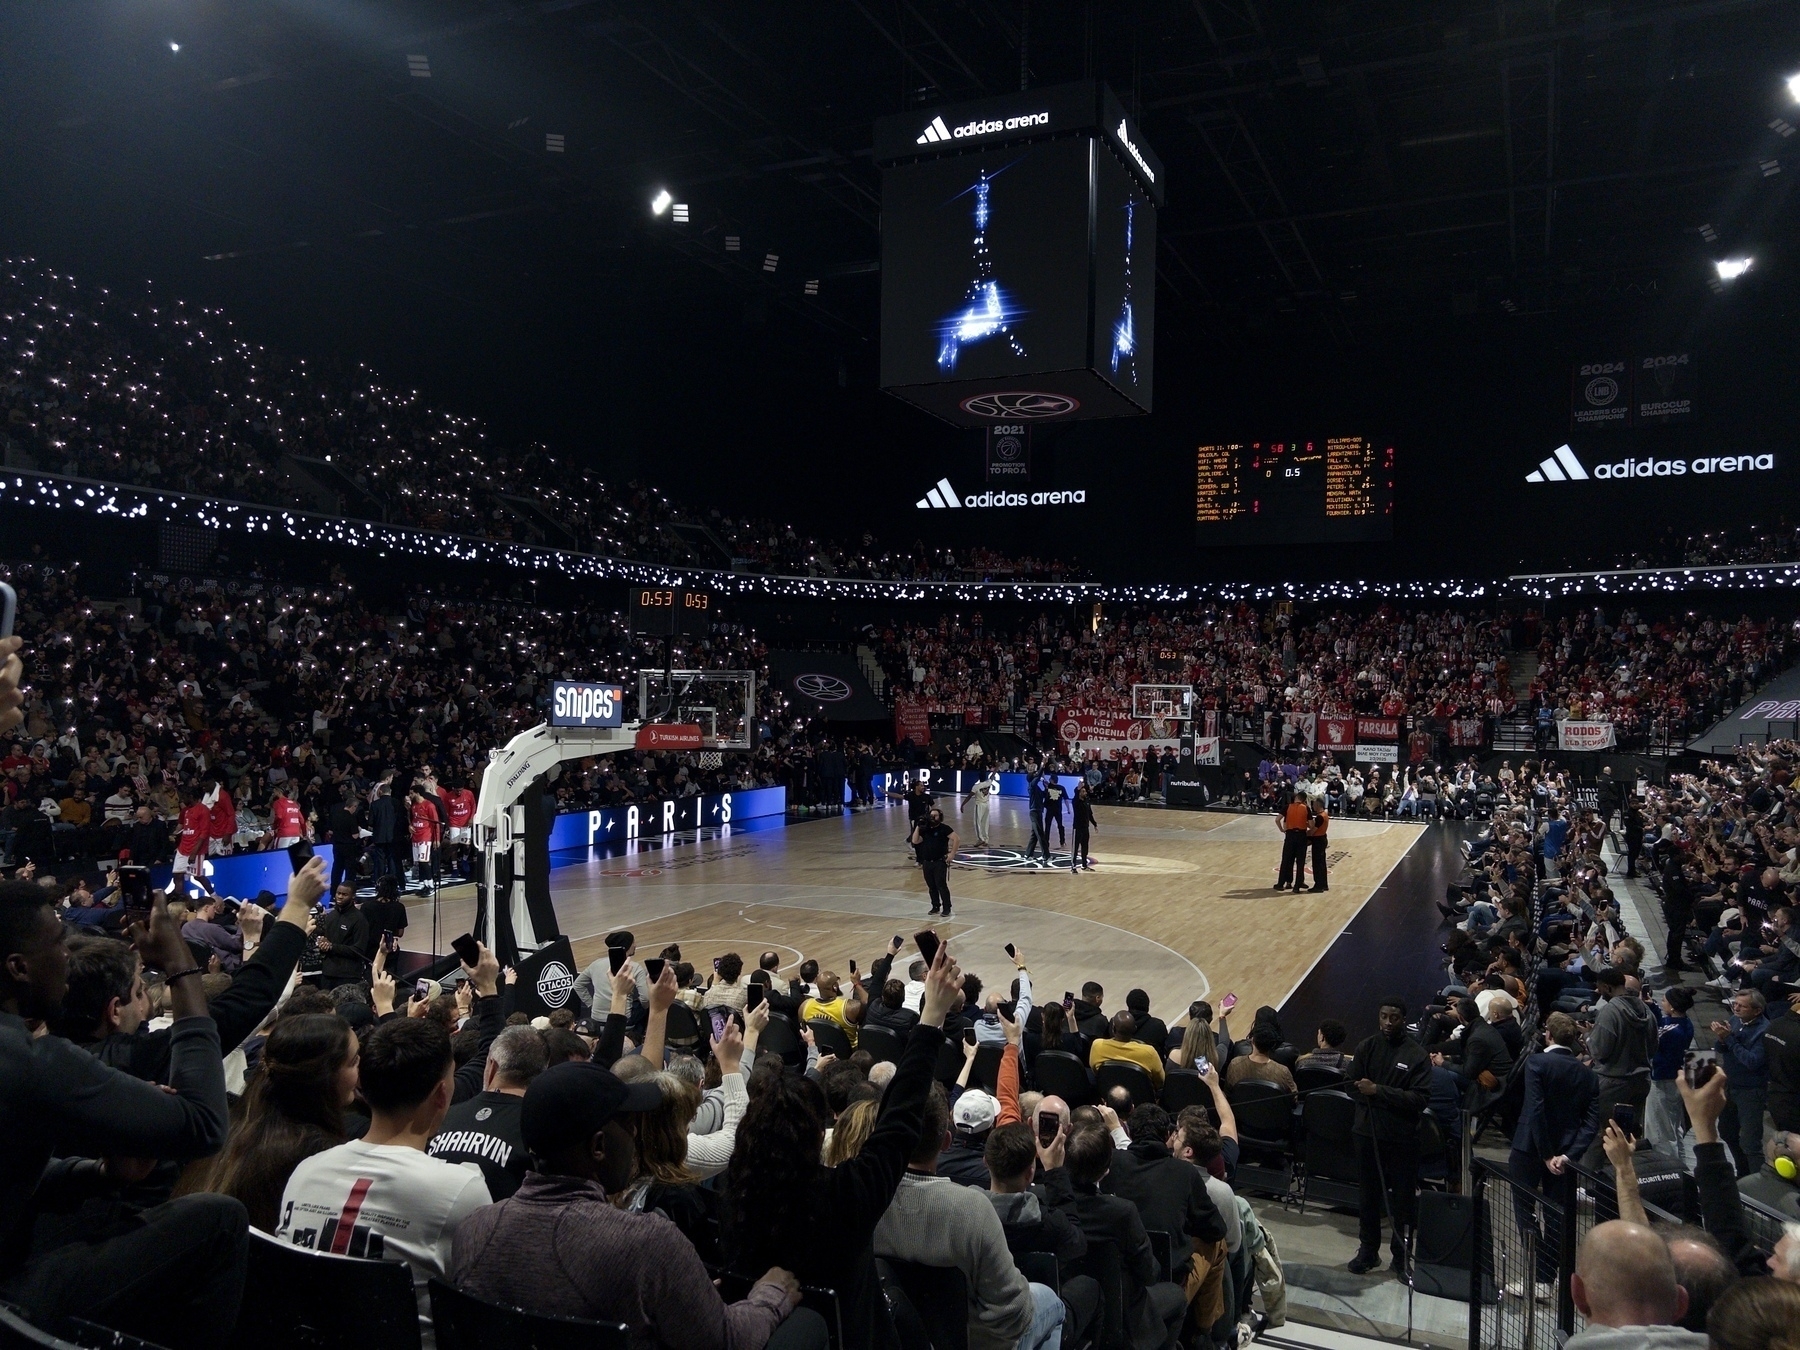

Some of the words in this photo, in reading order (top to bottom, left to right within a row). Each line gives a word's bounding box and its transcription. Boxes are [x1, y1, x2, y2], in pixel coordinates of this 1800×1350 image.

[954, 120, 1003, 138] adidas
[1005, 112, 1049, 130] arena
[1580, 361, 1625, 376] 2024
[1642, 354, 1689, 369] 2024
[1640, 400, 1691, 411] EUROCUP
[1640, 407, 1691, 417] CHAMPIONS
[1574, 409, 1610, 417] LEADERS
[1577, 413, 1625, 422] CHAMPIONS
[993, 425, 1025, 435] 2021
[990, 467, 1001, 475] TO
[1002, 467, 1020, 475] PRO
[1020, 467, 1028, 475] A
[1285, 468, 1301, 477] 0.5
[1593, 457, 1687, 479] adidas
[1691, 453, 1774, 473] arena
[964, 491, 1028, 508] adidas
[1030, 489, 1086, 505] arena
[641, 591, 673, 606] 0:53
[685, 592, 708, 609] 0:53
[554, 686, 613, 725] snipes
[1358, 721, 1399, 735] FARSALA
[1564, 726, 1600, 736] RODOS
[659, 733, 679, 742] TURKISH
[680, 734, 700, 743] AIRLINES
[506, 760, 531, 789] SPALDING
[539, 977, 572, 992] O'TACOS
[427, 1130, 513, 1168] SHAHRVIN
[1662, 1172, 1681, 1182] PRIVÉE
